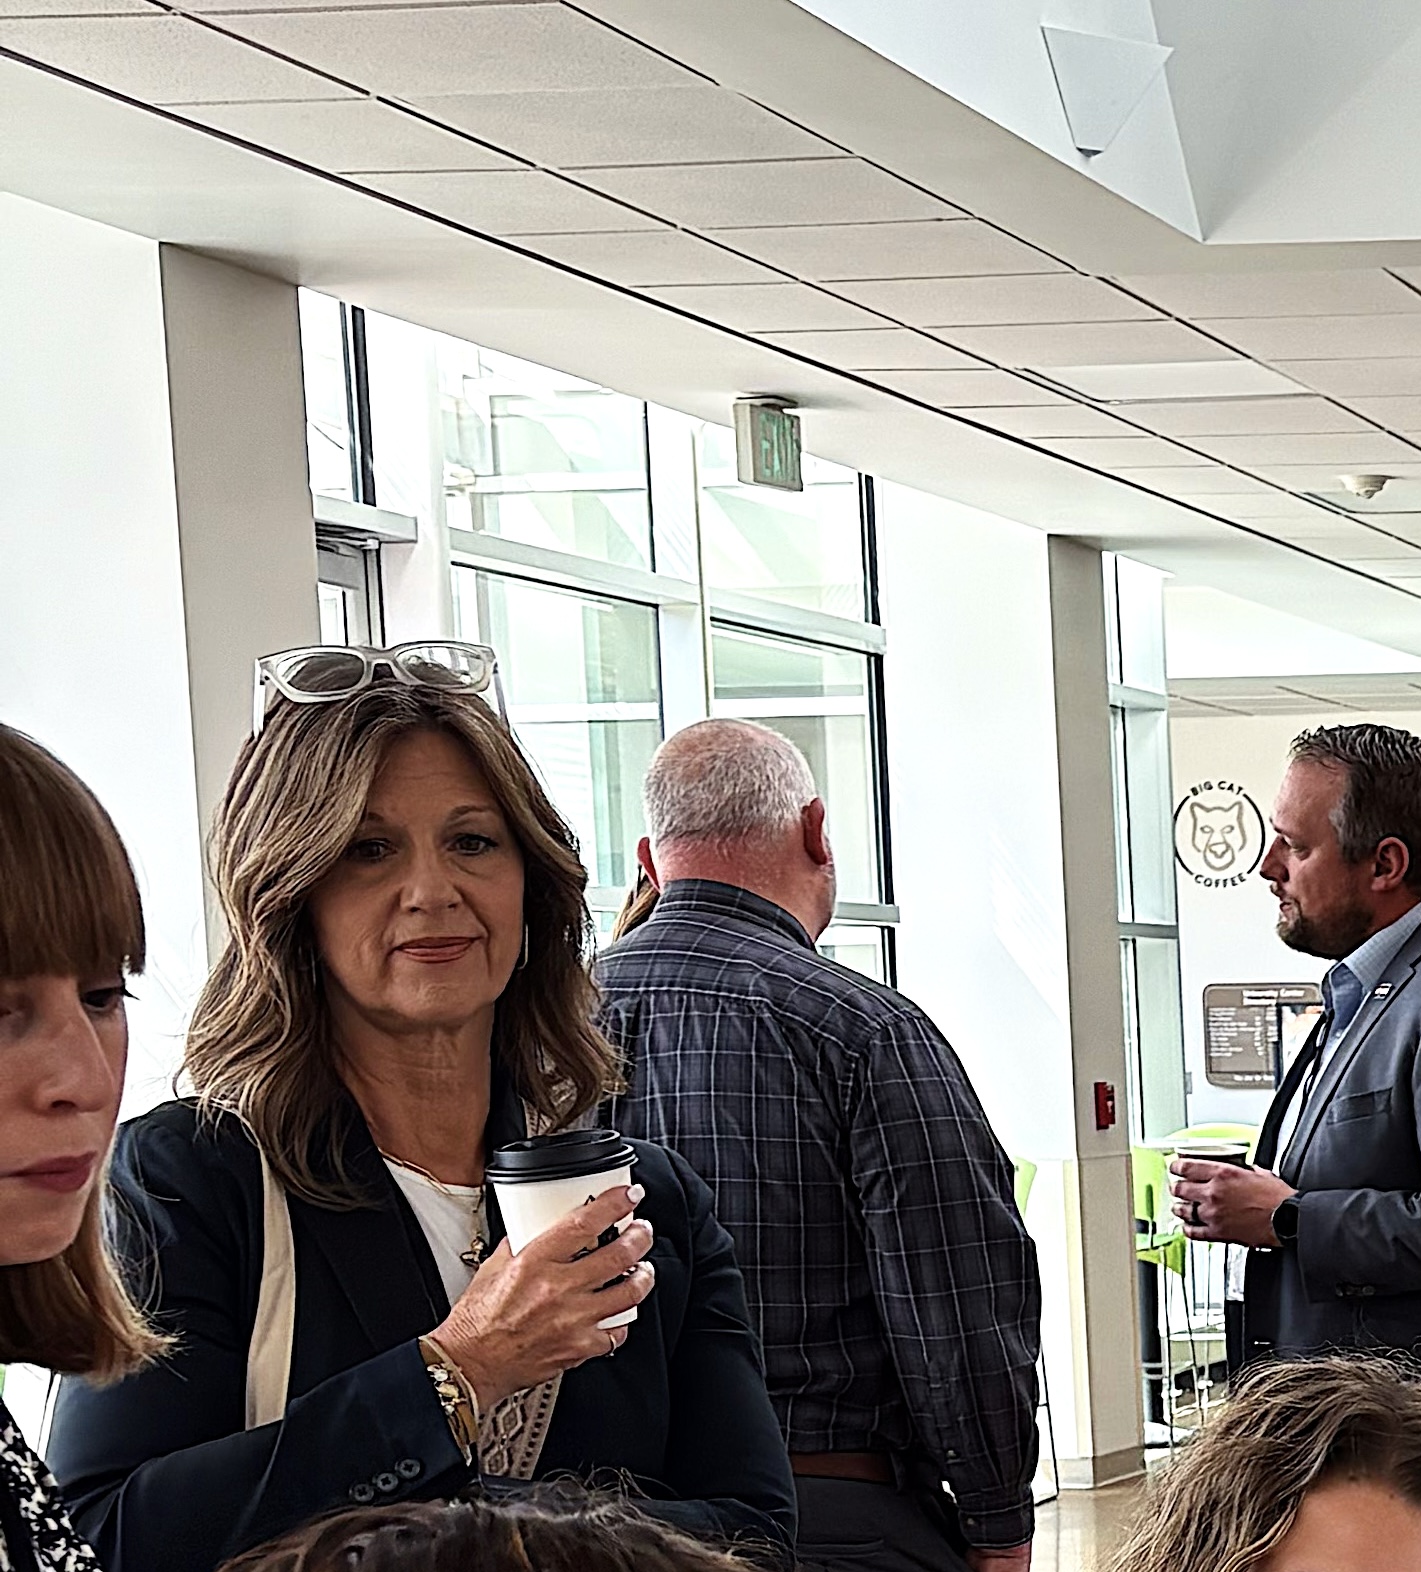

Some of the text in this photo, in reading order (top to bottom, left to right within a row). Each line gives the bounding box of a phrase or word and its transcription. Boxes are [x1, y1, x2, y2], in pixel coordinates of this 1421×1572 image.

[1190, 780, 1244, 796] BIG CAT
[1194, 872, 1247, 888] COFFEE
